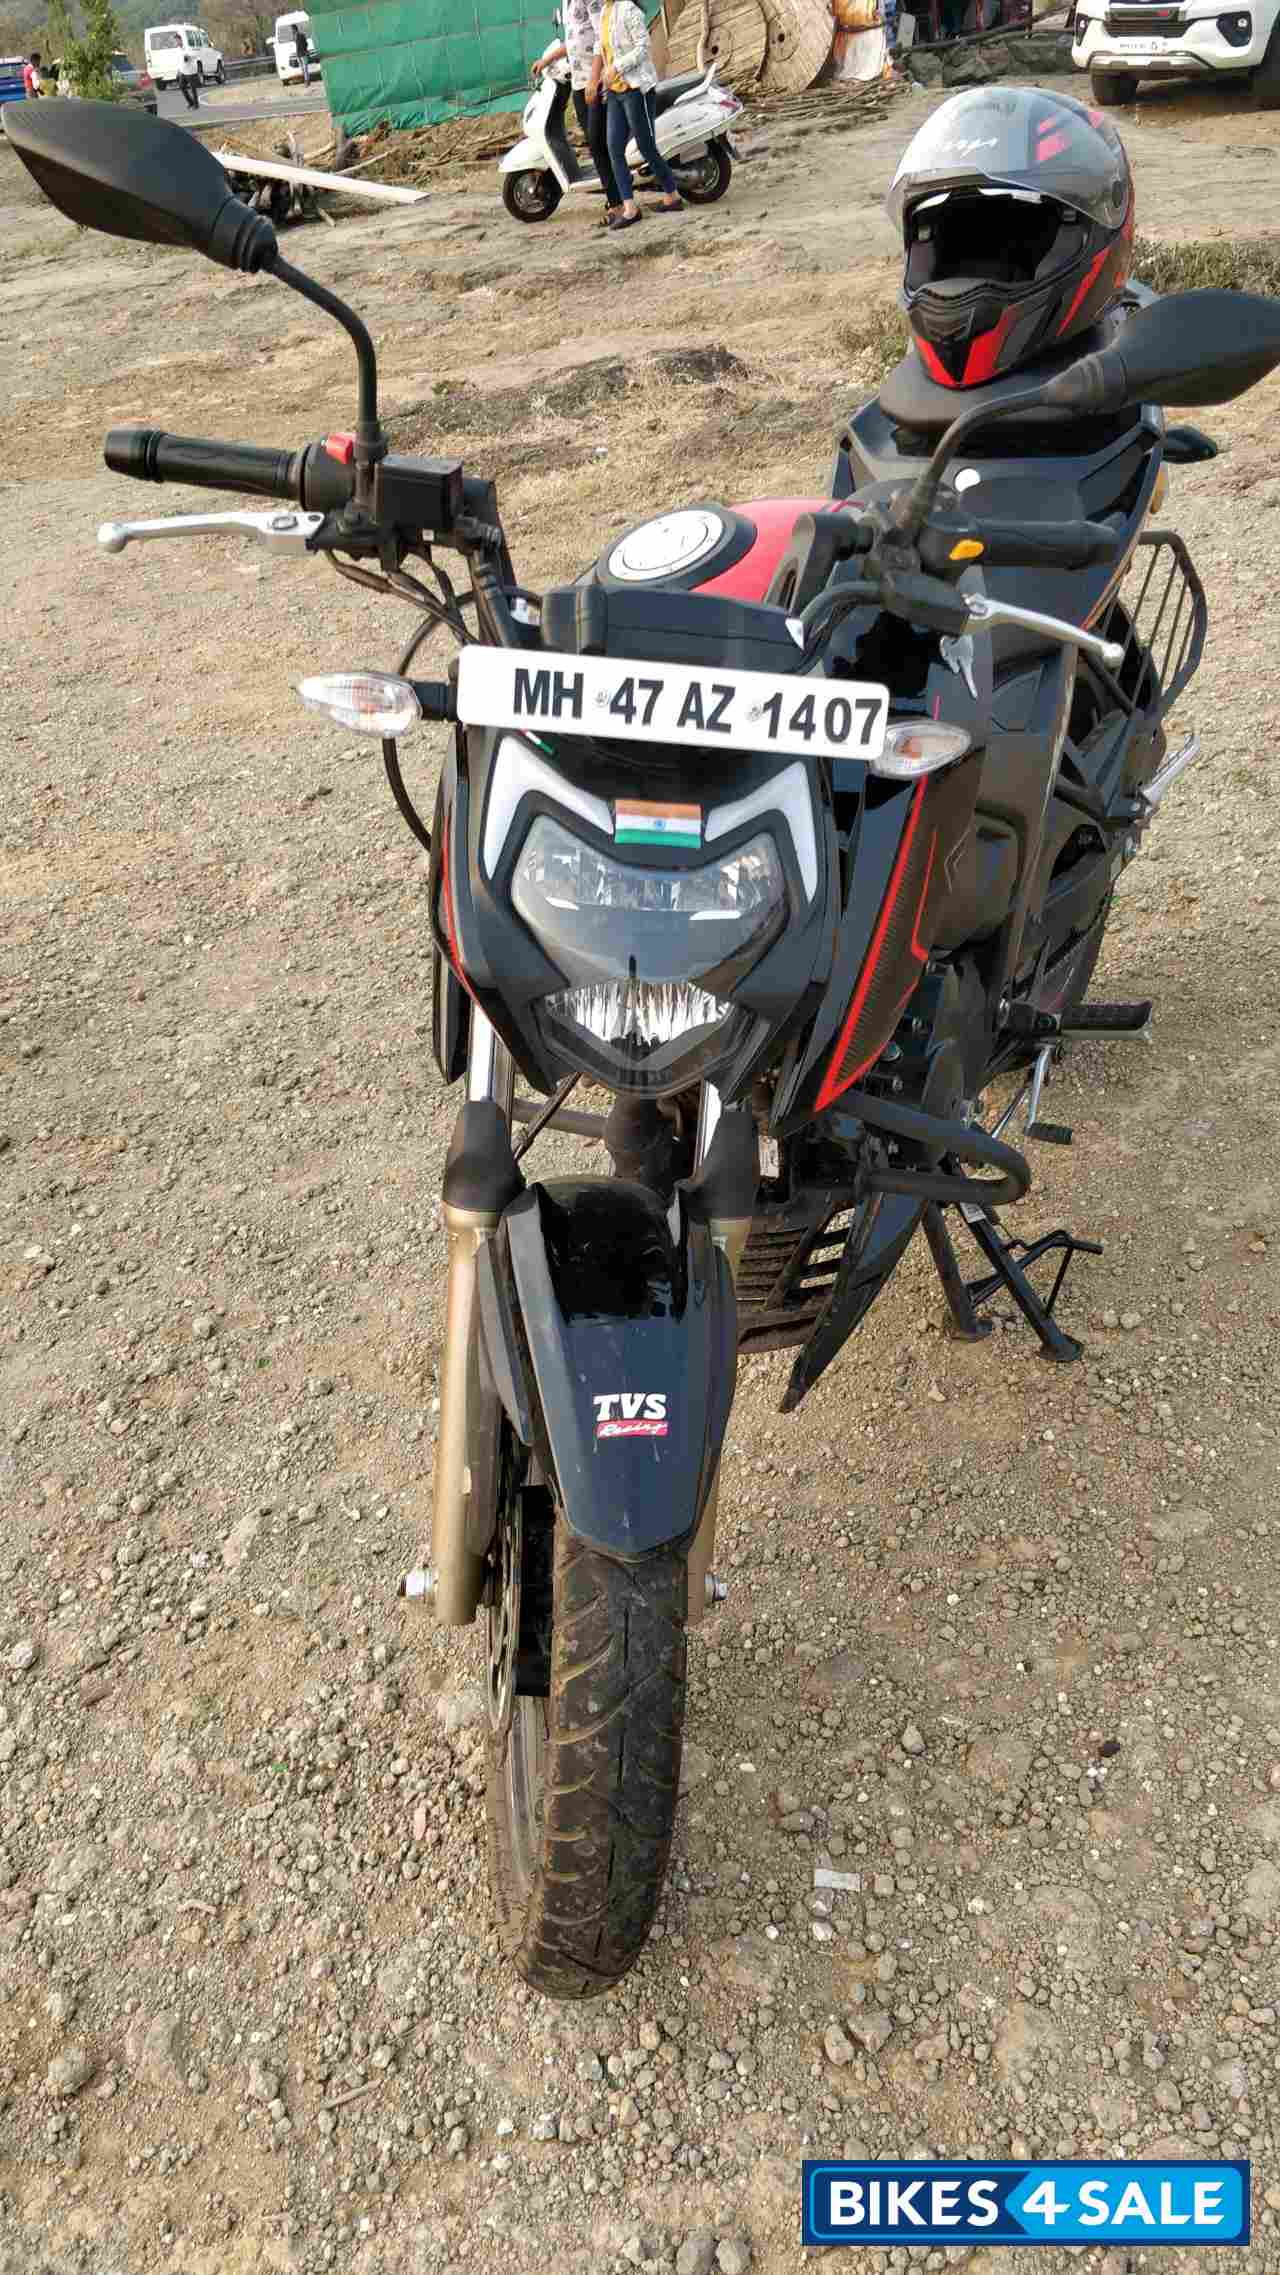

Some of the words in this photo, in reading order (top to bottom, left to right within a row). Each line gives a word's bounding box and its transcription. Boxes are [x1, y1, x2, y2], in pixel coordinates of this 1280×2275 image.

[513, 667, 584, 719] MH
[609, 677, 665, 725] 47
[676, 681, 736, 733] AZ
[762, 692, 882, 745] 1407
[593, 1393, 667, 1422] TVS
